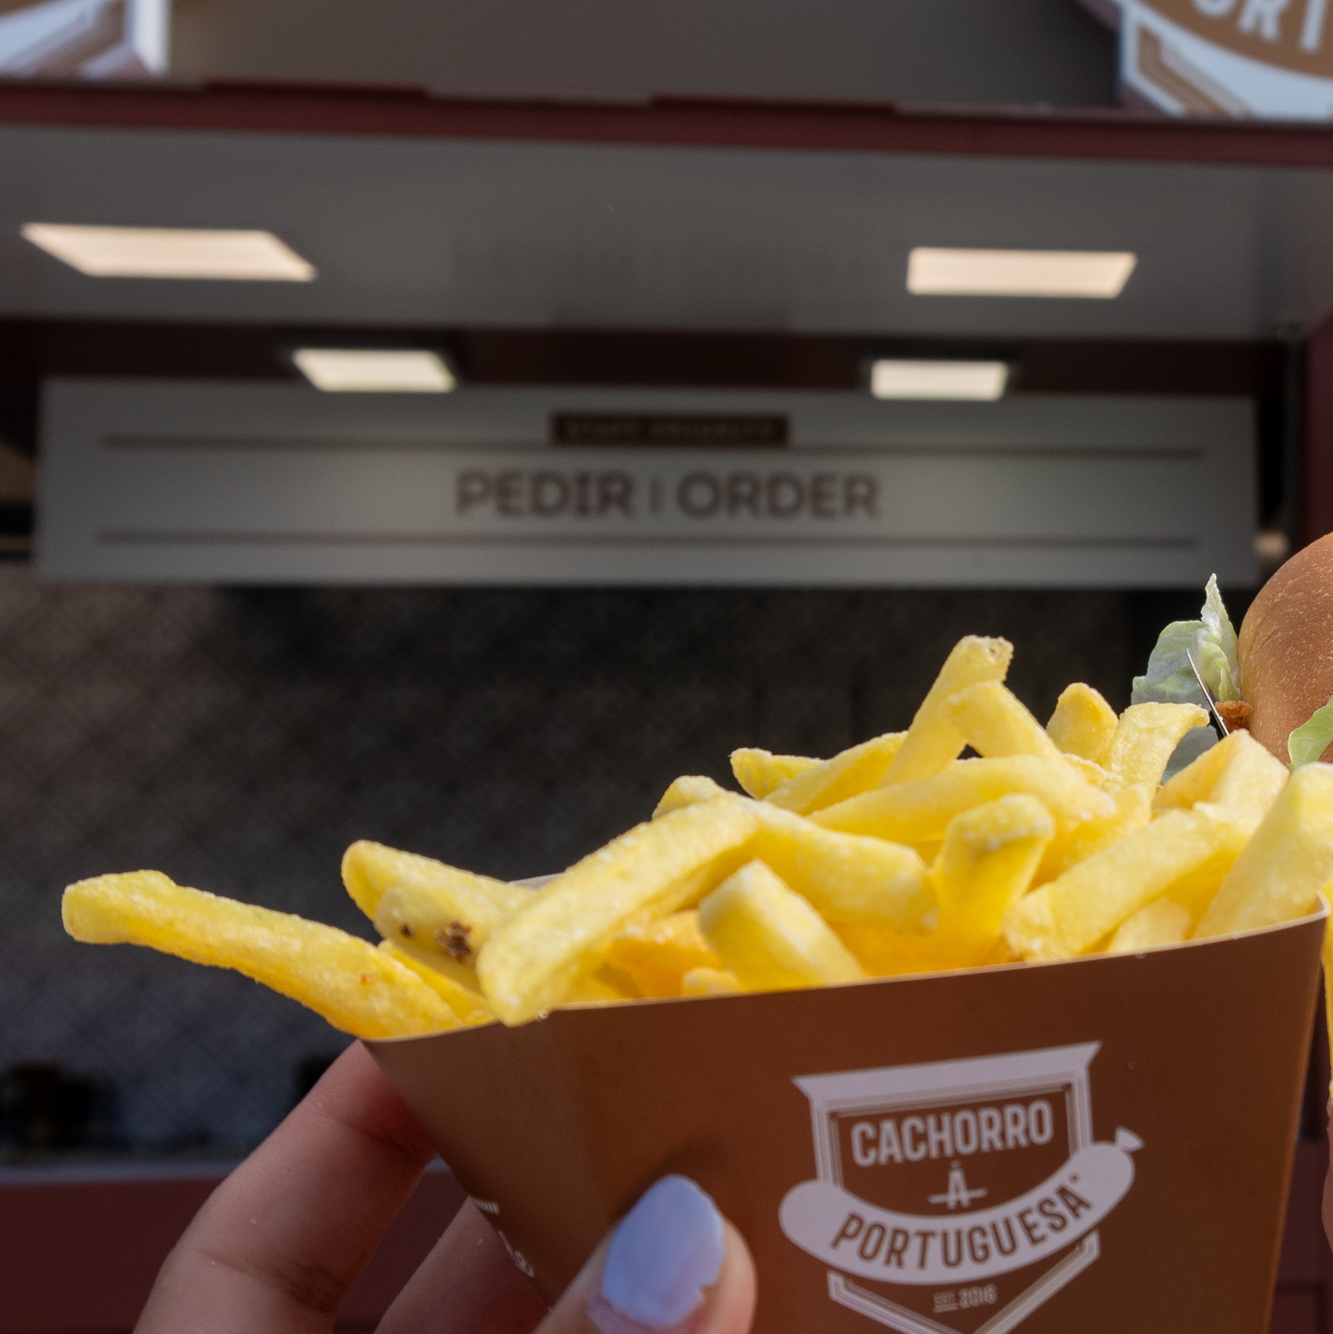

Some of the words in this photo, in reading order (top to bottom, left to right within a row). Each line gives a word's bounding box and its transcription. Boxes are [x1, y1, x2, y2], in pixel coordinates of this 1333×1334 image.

[453, 468, 636, 520] PEDIR
[676, 470, 881, 520] ORDER
[850, 1099, 1054, 1166] CACHORRO
[830, 1185, 1093, 1271] PORTUGUESA
[958, 1283, 998, 1309] 2016
